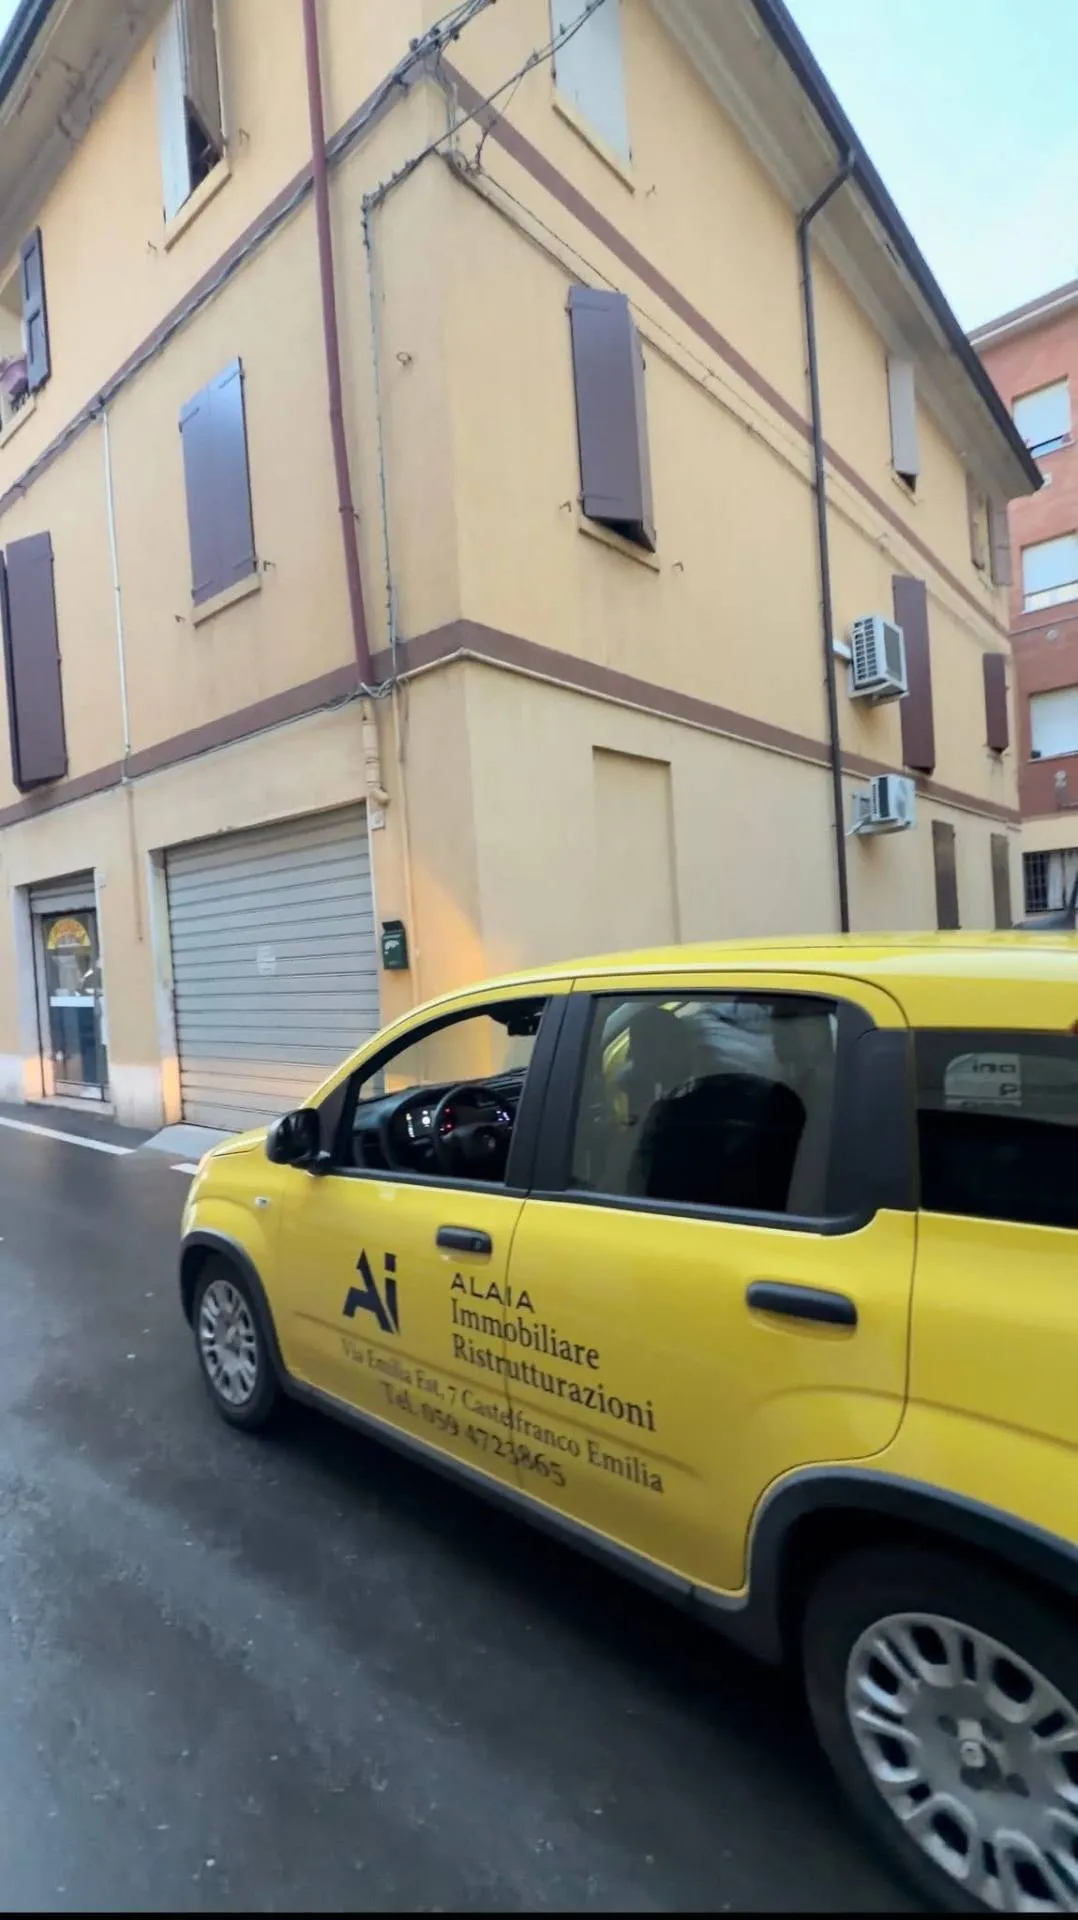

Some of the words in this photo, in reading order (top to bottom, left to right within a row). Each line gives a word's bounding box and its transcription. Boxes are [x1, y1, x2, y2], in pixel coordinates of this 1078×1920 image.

[451, 1272, 535, 1314] ALAIA
[451, 1298, 601, 1370] Immobiliare
[341, 1337, 364, 1364] Via
[367, 1348, 413, 1385] Emilia
[447, 1385, 457, 1406] 7
[461, 1389, 581, 1458] Castelfranco
[586, 1438, 664, 1494] Emilia
[380, 1379, 417, 1416] Tel.
[421, 1403, 459, 1436] 059
[452, 1333, 657, 1433] Ristrutturazioni
